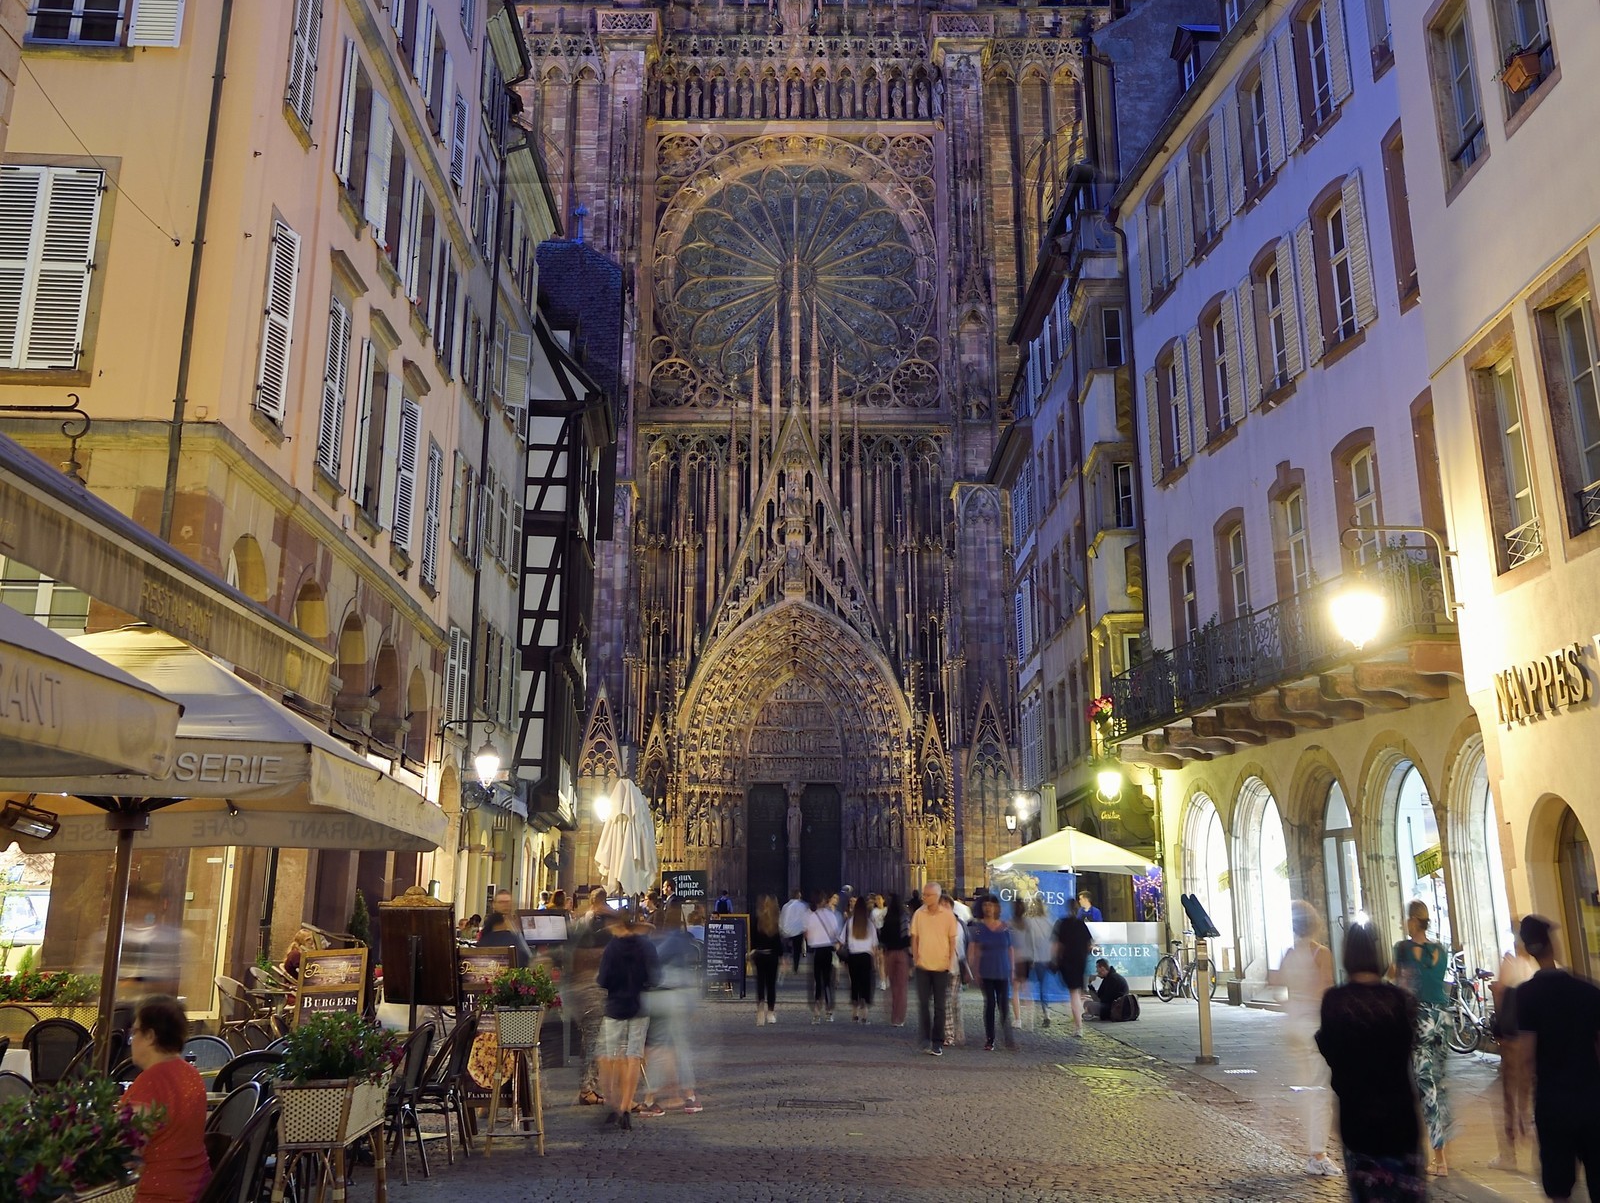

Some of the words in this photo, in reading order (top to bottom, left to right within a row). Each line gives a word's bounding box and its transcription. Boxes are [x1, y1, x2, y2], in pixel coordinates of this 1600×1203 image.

[1493, 643, 1588, 724] NAPPES
[0, 660, 62, 728] ANT
[678, 881, 699, 889] douze
[1091, 947, 1151, 957] GLACIER
[303, 996, 358, 1009] BURGERS
